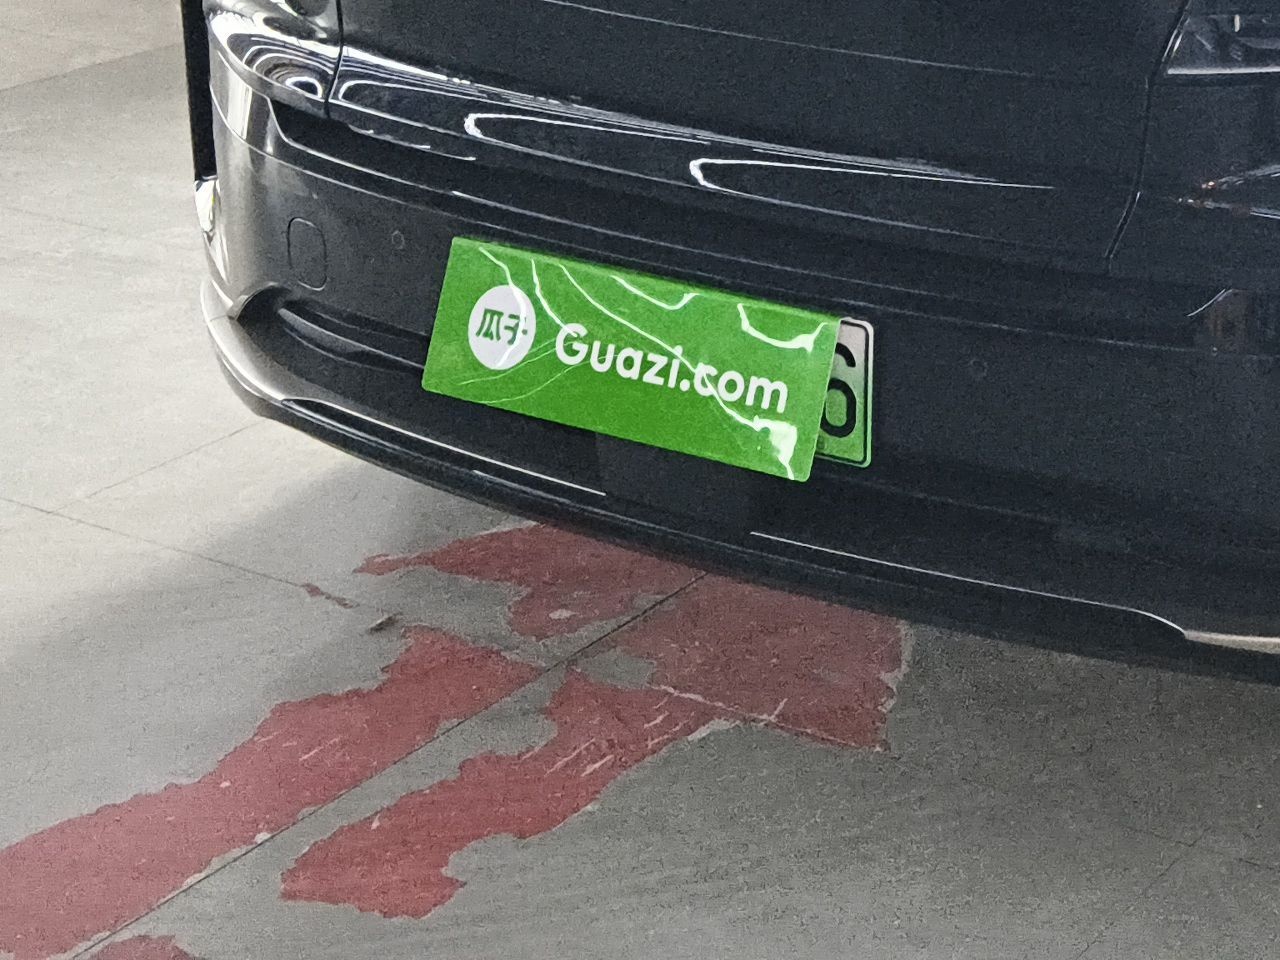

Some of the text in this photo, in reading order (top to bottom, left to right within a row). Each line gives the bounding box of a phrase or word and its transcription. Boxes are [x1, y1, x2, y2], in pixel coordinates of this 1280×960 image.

[476, 308, 528, 345] 瓜子
[555, 323, 788, 413] Guazi.com
[819, 342, 856, 438] 6
